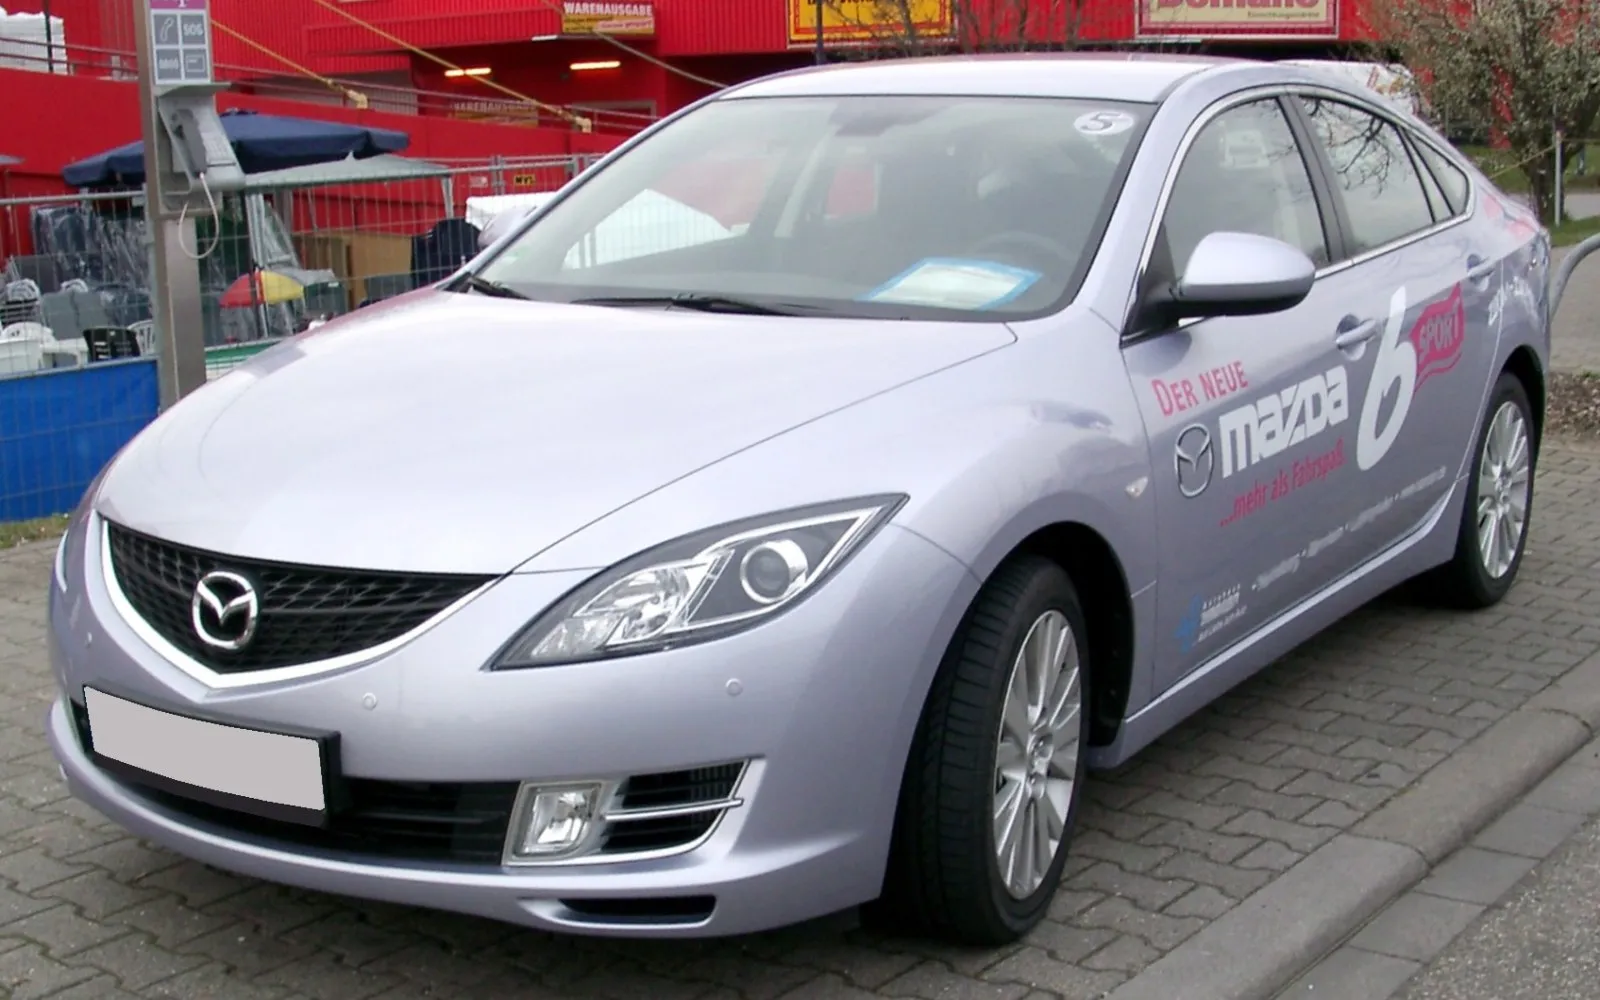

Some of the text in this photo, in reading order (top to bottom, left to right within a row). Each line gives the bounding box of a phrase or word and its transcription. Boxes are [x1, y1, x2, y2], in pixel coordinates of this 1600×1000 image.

[563, 2, 653, 16] WARENAUSGABE
[1081, 112, 1122, 132] 5
[1356, 286, 1417, 471] 6
